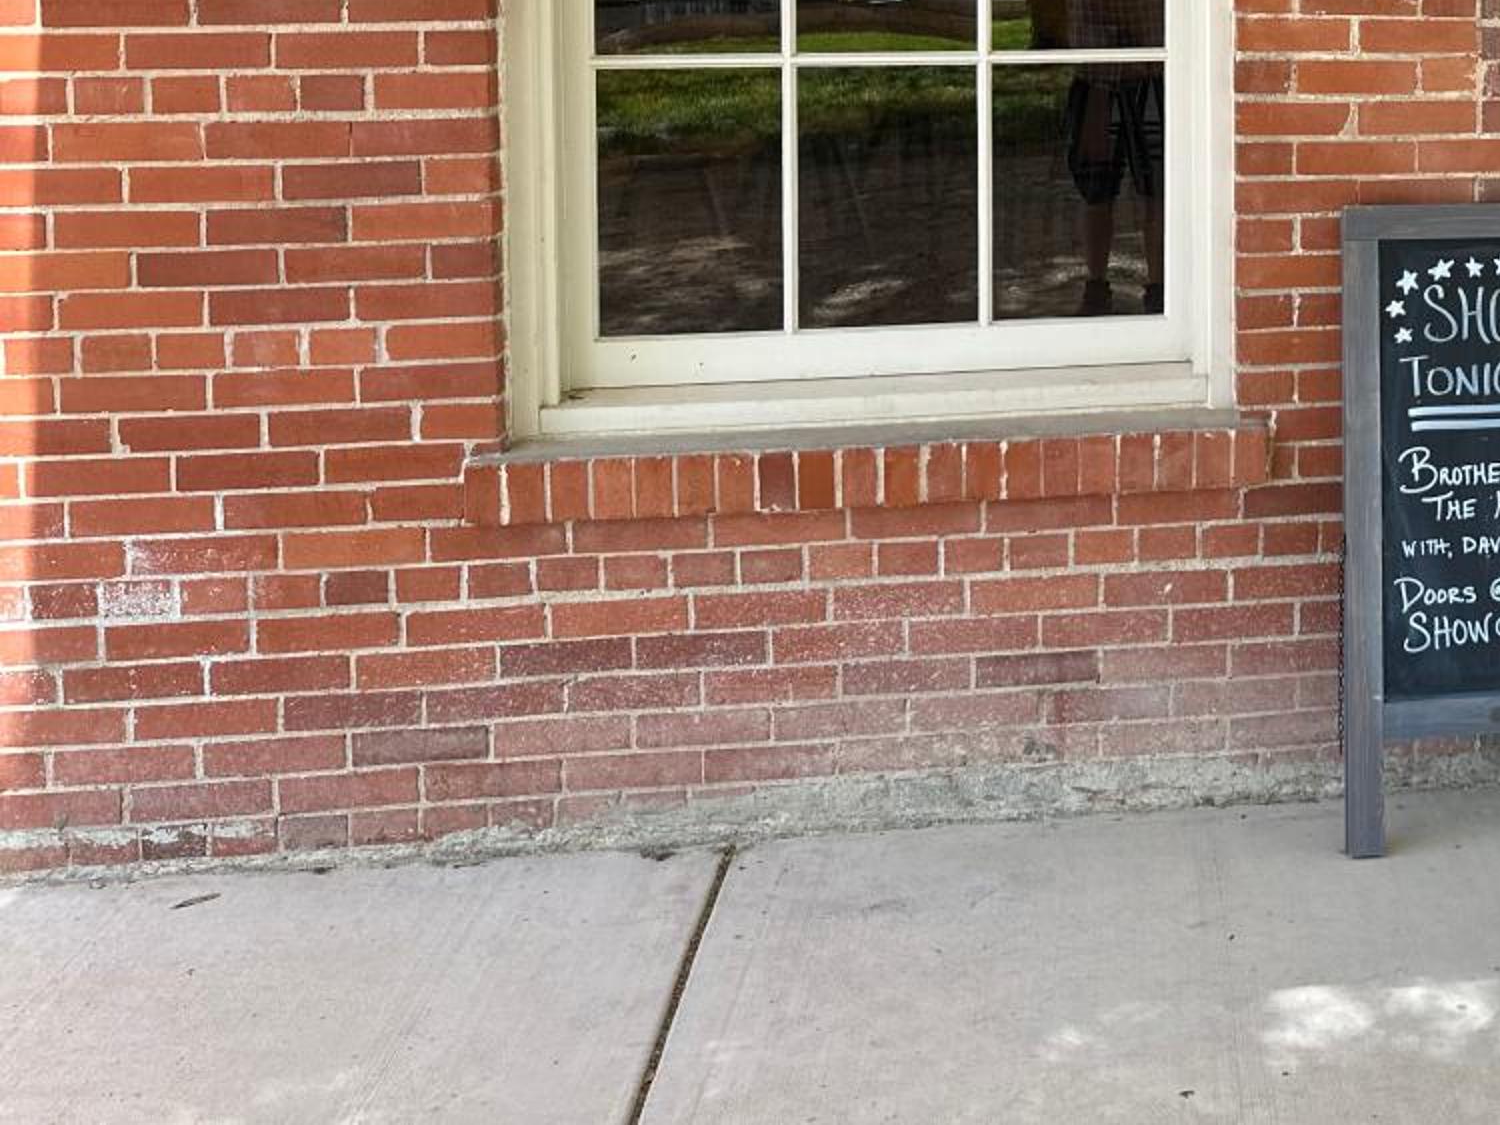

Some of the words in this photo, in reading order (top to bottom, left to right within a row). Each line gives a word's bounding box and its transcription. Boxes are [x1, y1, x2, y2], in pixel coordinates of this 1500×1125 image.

[1421, 490, 1477, 521] THE
[1394, 576, 1477, 613] DOORS
[1403, 610, 1493, 654] SHOW
